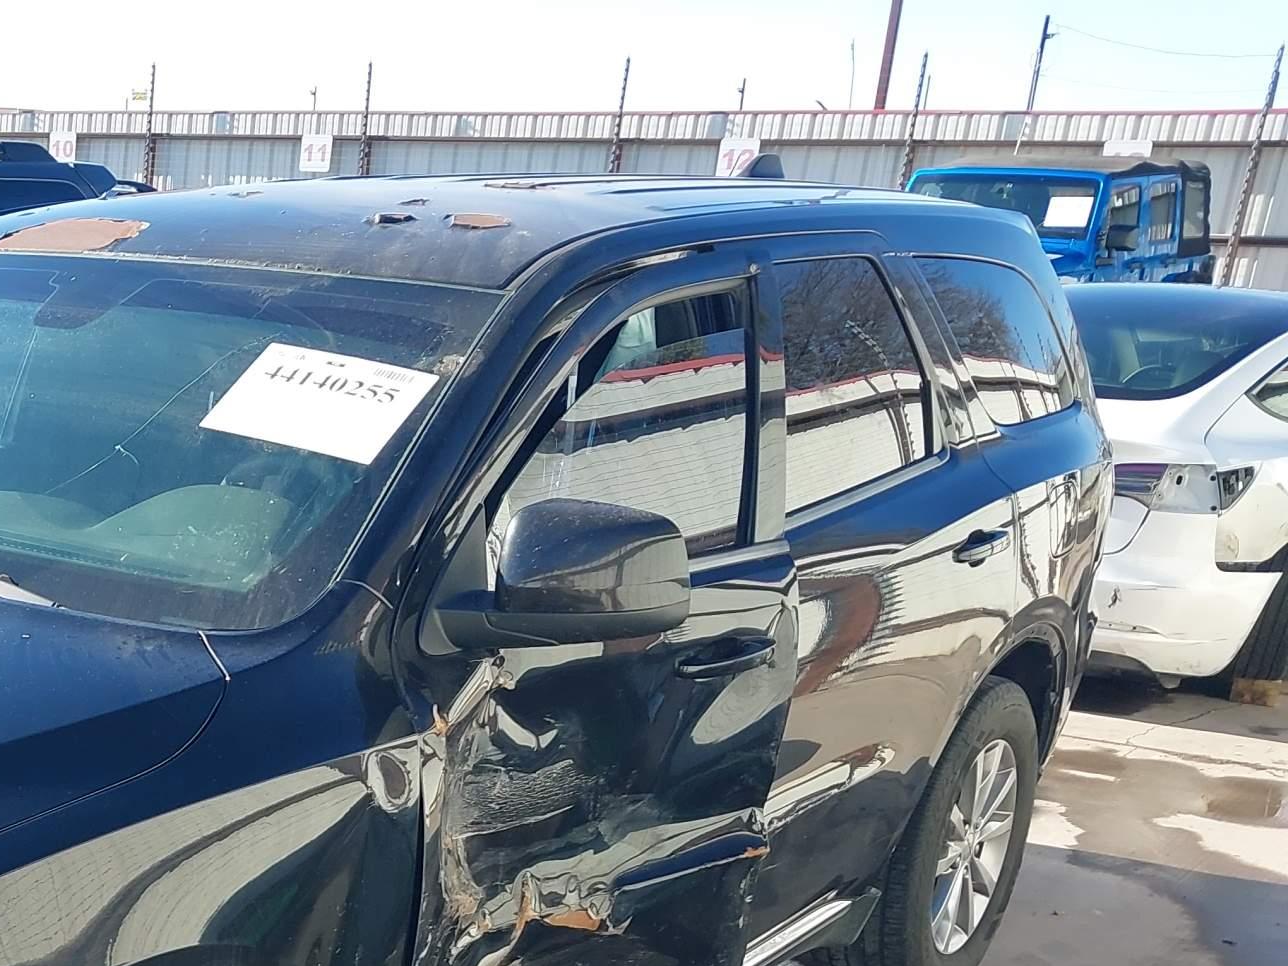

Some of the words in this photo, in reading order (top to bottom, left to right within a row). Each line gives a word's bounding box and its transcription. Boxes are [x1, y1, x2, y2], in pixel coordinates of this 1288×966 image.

[52, 140, 74, 158] 10
[304, 143, 327, 162] 11
[722, 148, 755, 170] 12
[264, 365, 400, 403] 44140255
